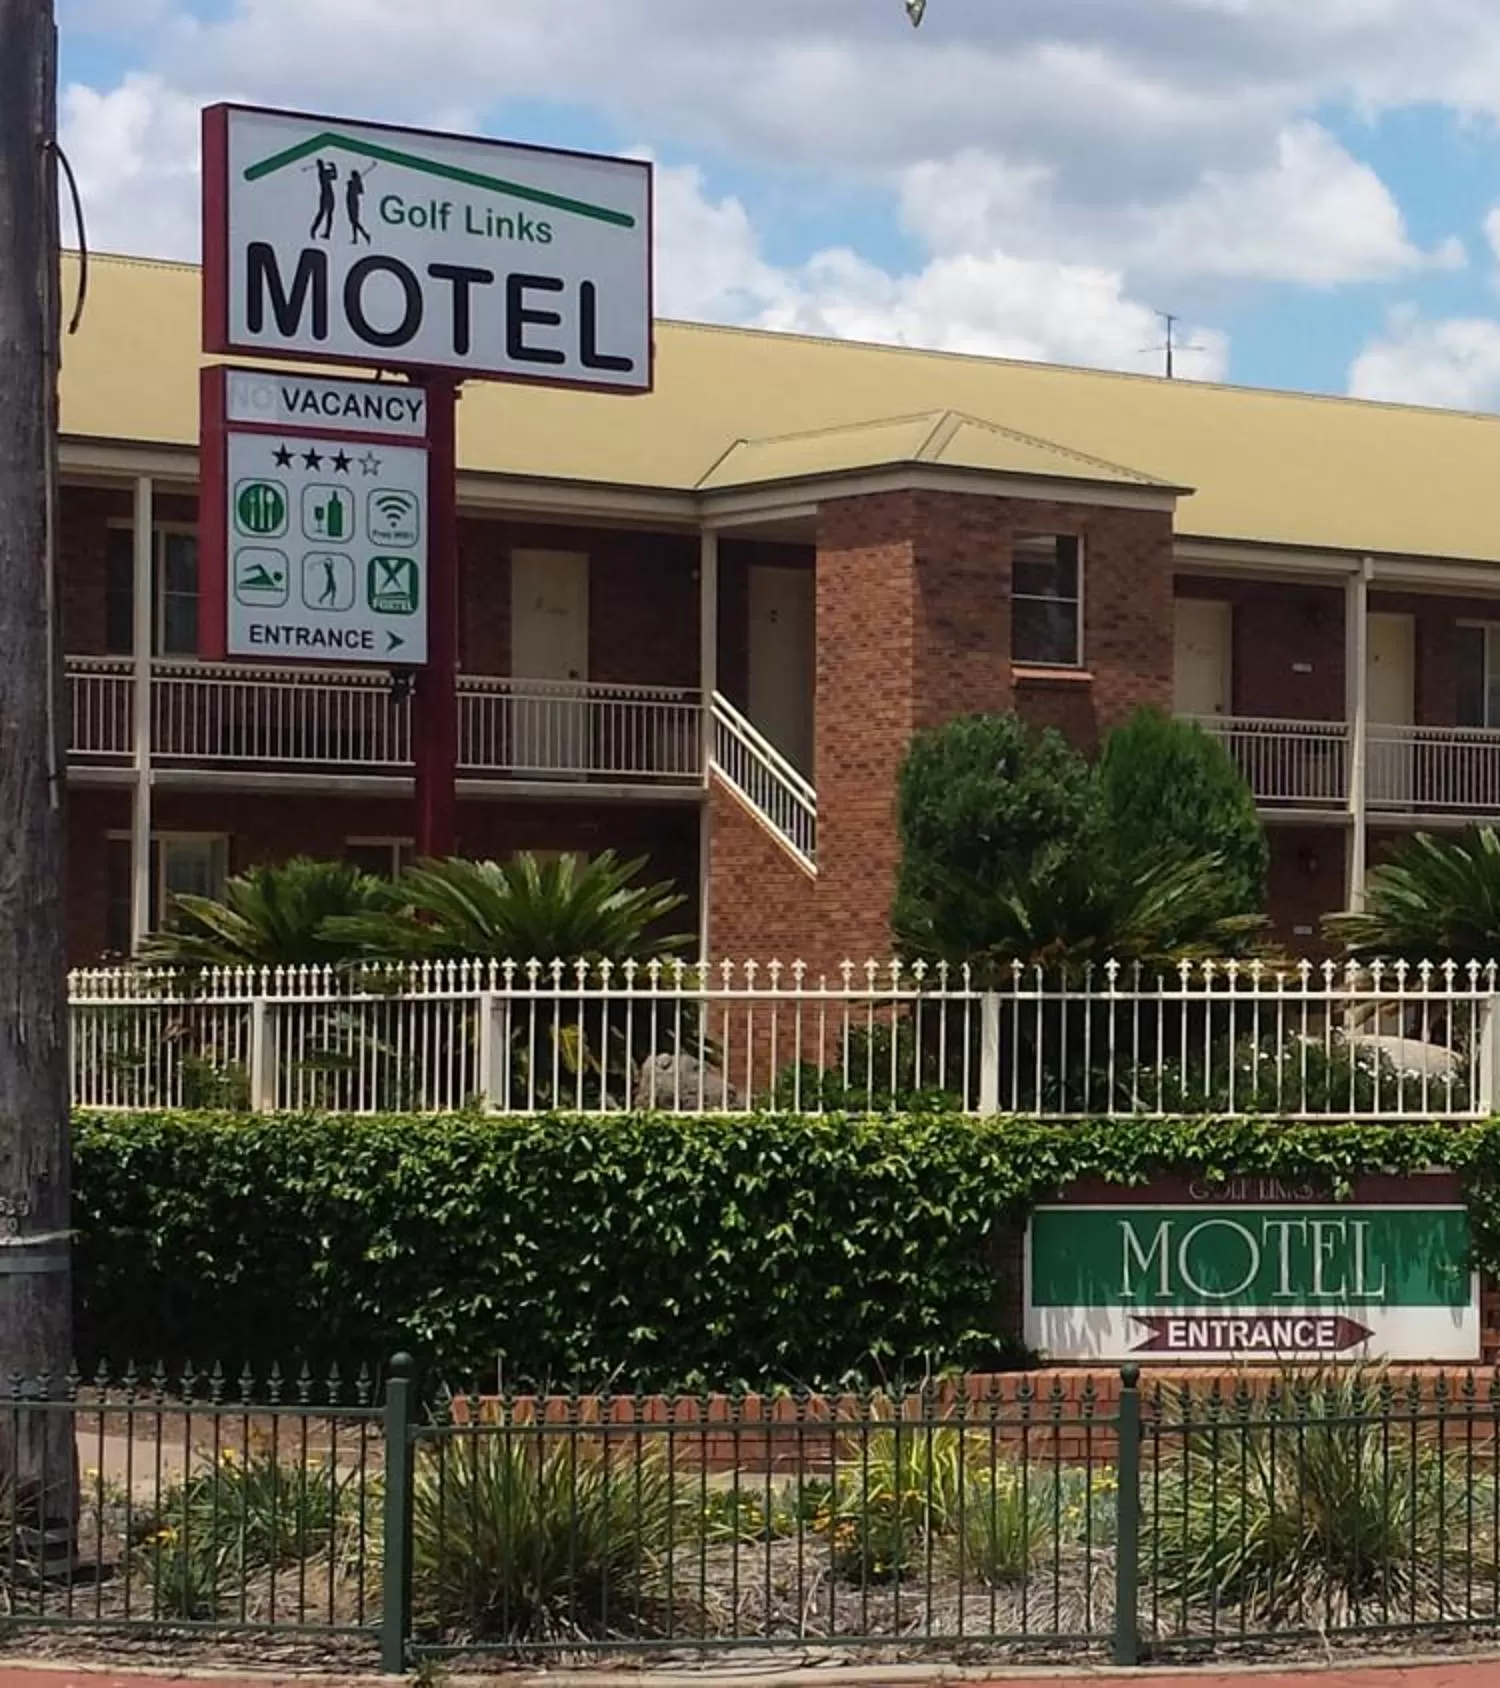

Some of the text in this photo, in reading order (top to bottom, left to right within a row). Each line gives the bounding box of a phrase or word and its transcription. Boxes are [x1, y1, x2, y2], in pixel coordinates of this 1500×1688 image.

[379, 194, 553, 244] Golf Links
[247, 241, 634, 373] MOTEL
[282, 386, 425, 423] VACANCY
[249, 623, 375, 649] ENTRANCE
[1117, 1218, 1387, 1300] MOTEL
[1167, 1319, 1336, 1349] ENTRANCE
